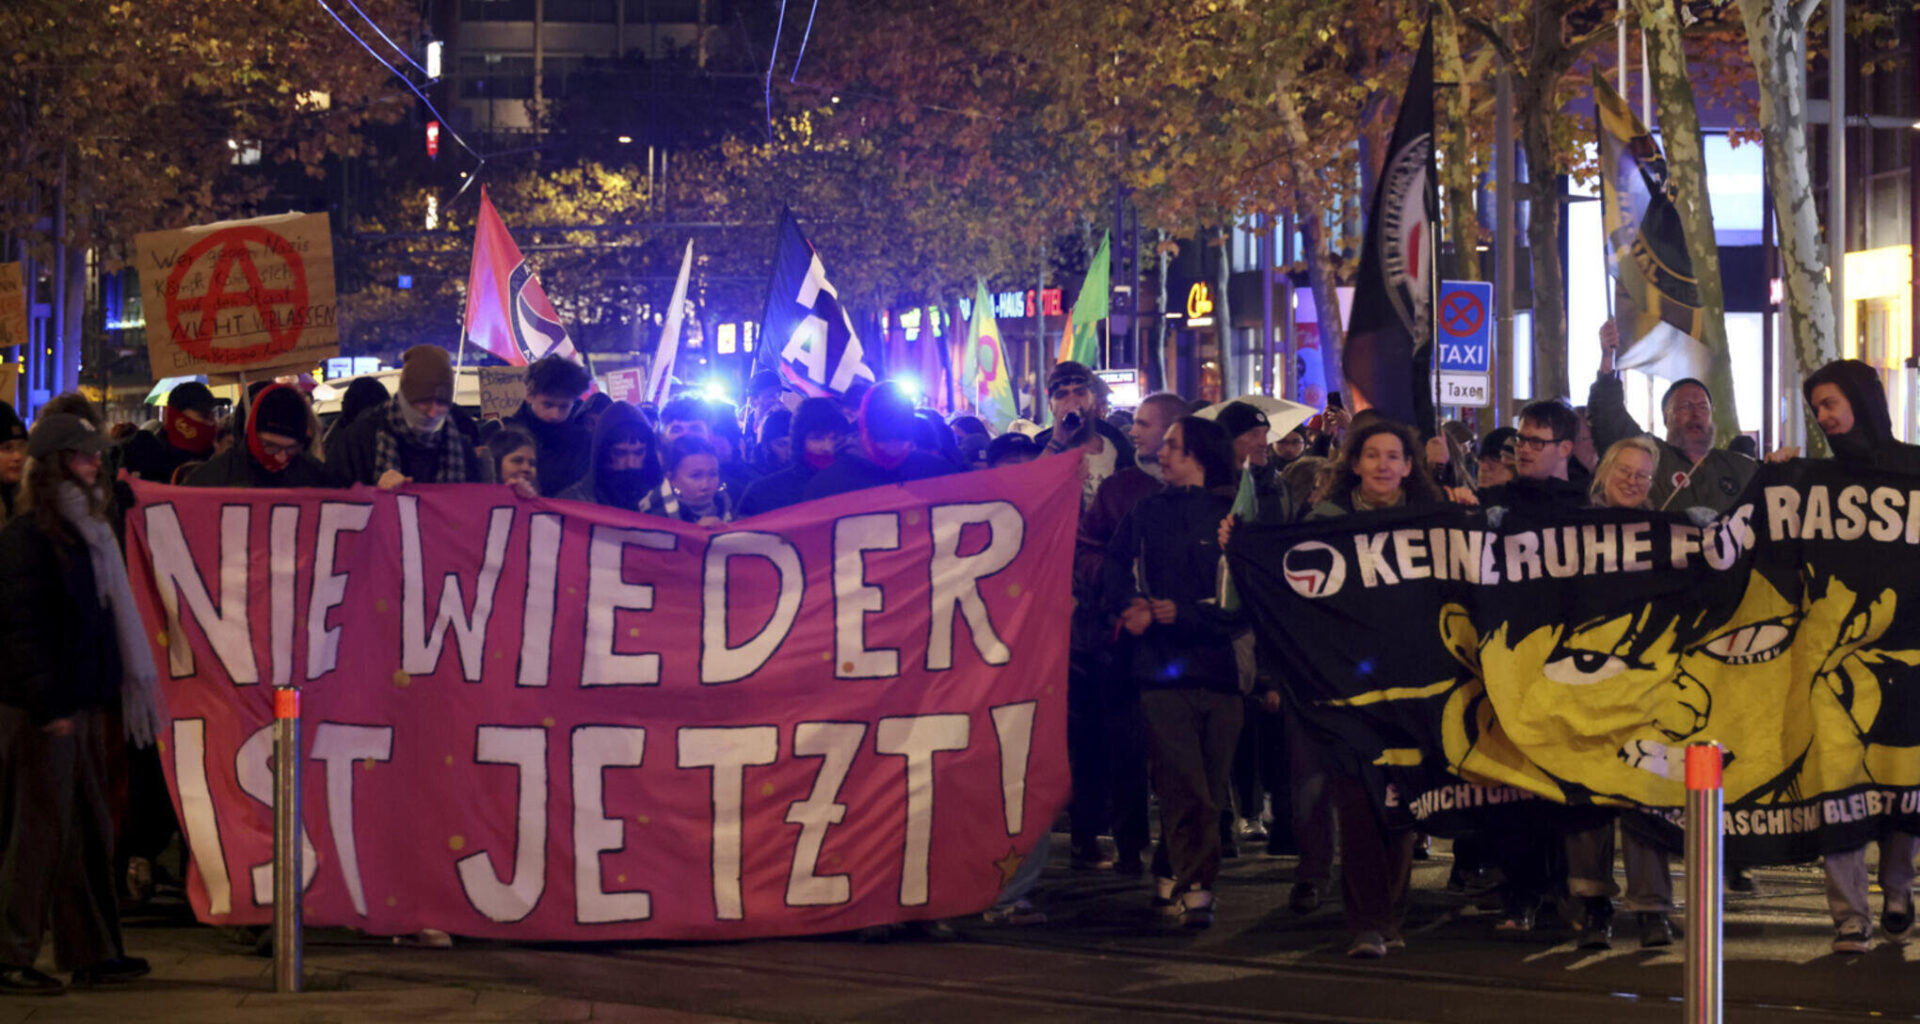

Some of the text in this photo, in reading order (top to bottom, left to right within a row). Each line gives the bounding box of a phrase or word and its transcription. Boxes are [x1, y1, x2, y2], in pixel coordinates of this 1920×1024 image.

[170, 313, 244, 340] NICHT
[1438, 343, 1484, 365] TAXI
[1503, 521, 1653, 583] RUHE
[1763, 484, 1920, 545] RASSI
[144, 494, 1026, 688] NIE WIEDER
[172, 699, 1038, 925] IST JETZT!
[1823, 789, 1897, 825] BLEIBT
